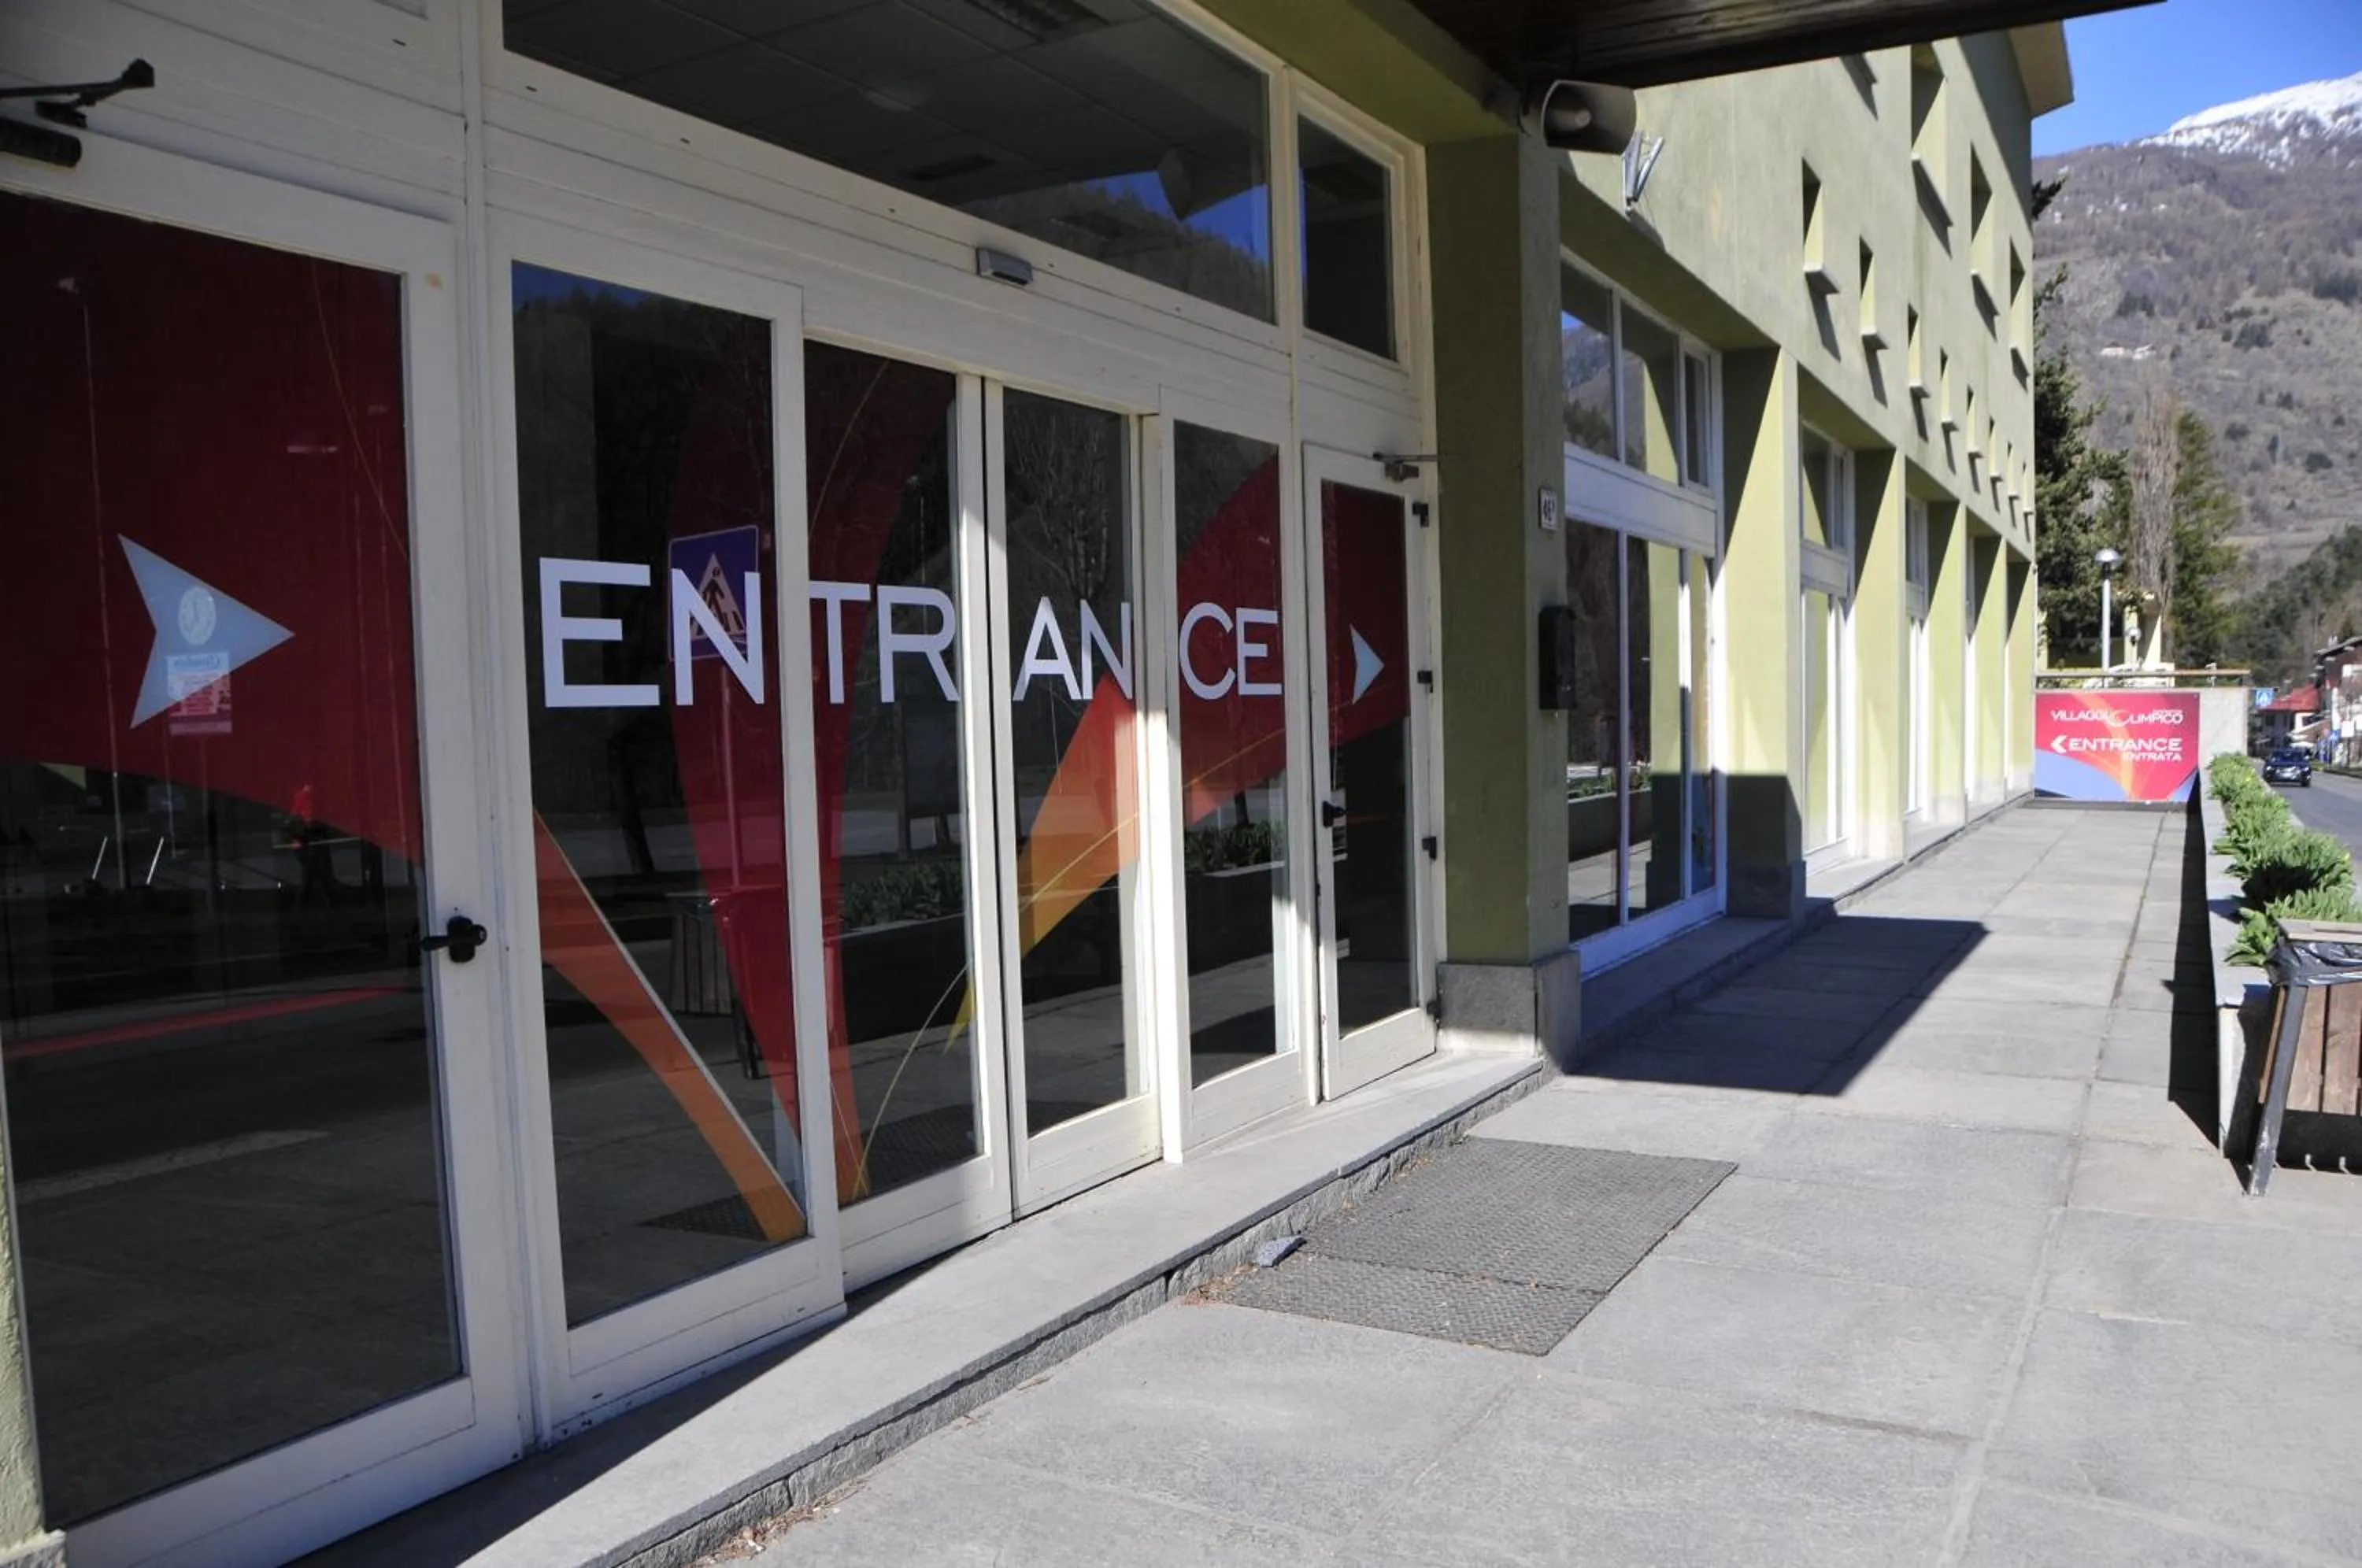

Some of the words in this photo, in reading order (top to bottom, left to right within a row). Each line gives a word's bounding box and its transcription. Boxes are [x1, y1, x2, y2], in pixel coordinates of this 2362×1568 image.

[539, 556, 1283, 708] ENTRANCE
[2068, 738, 2182, 752] ENTRANCE
[2123, 752, 2182, 762] ENTRATA
